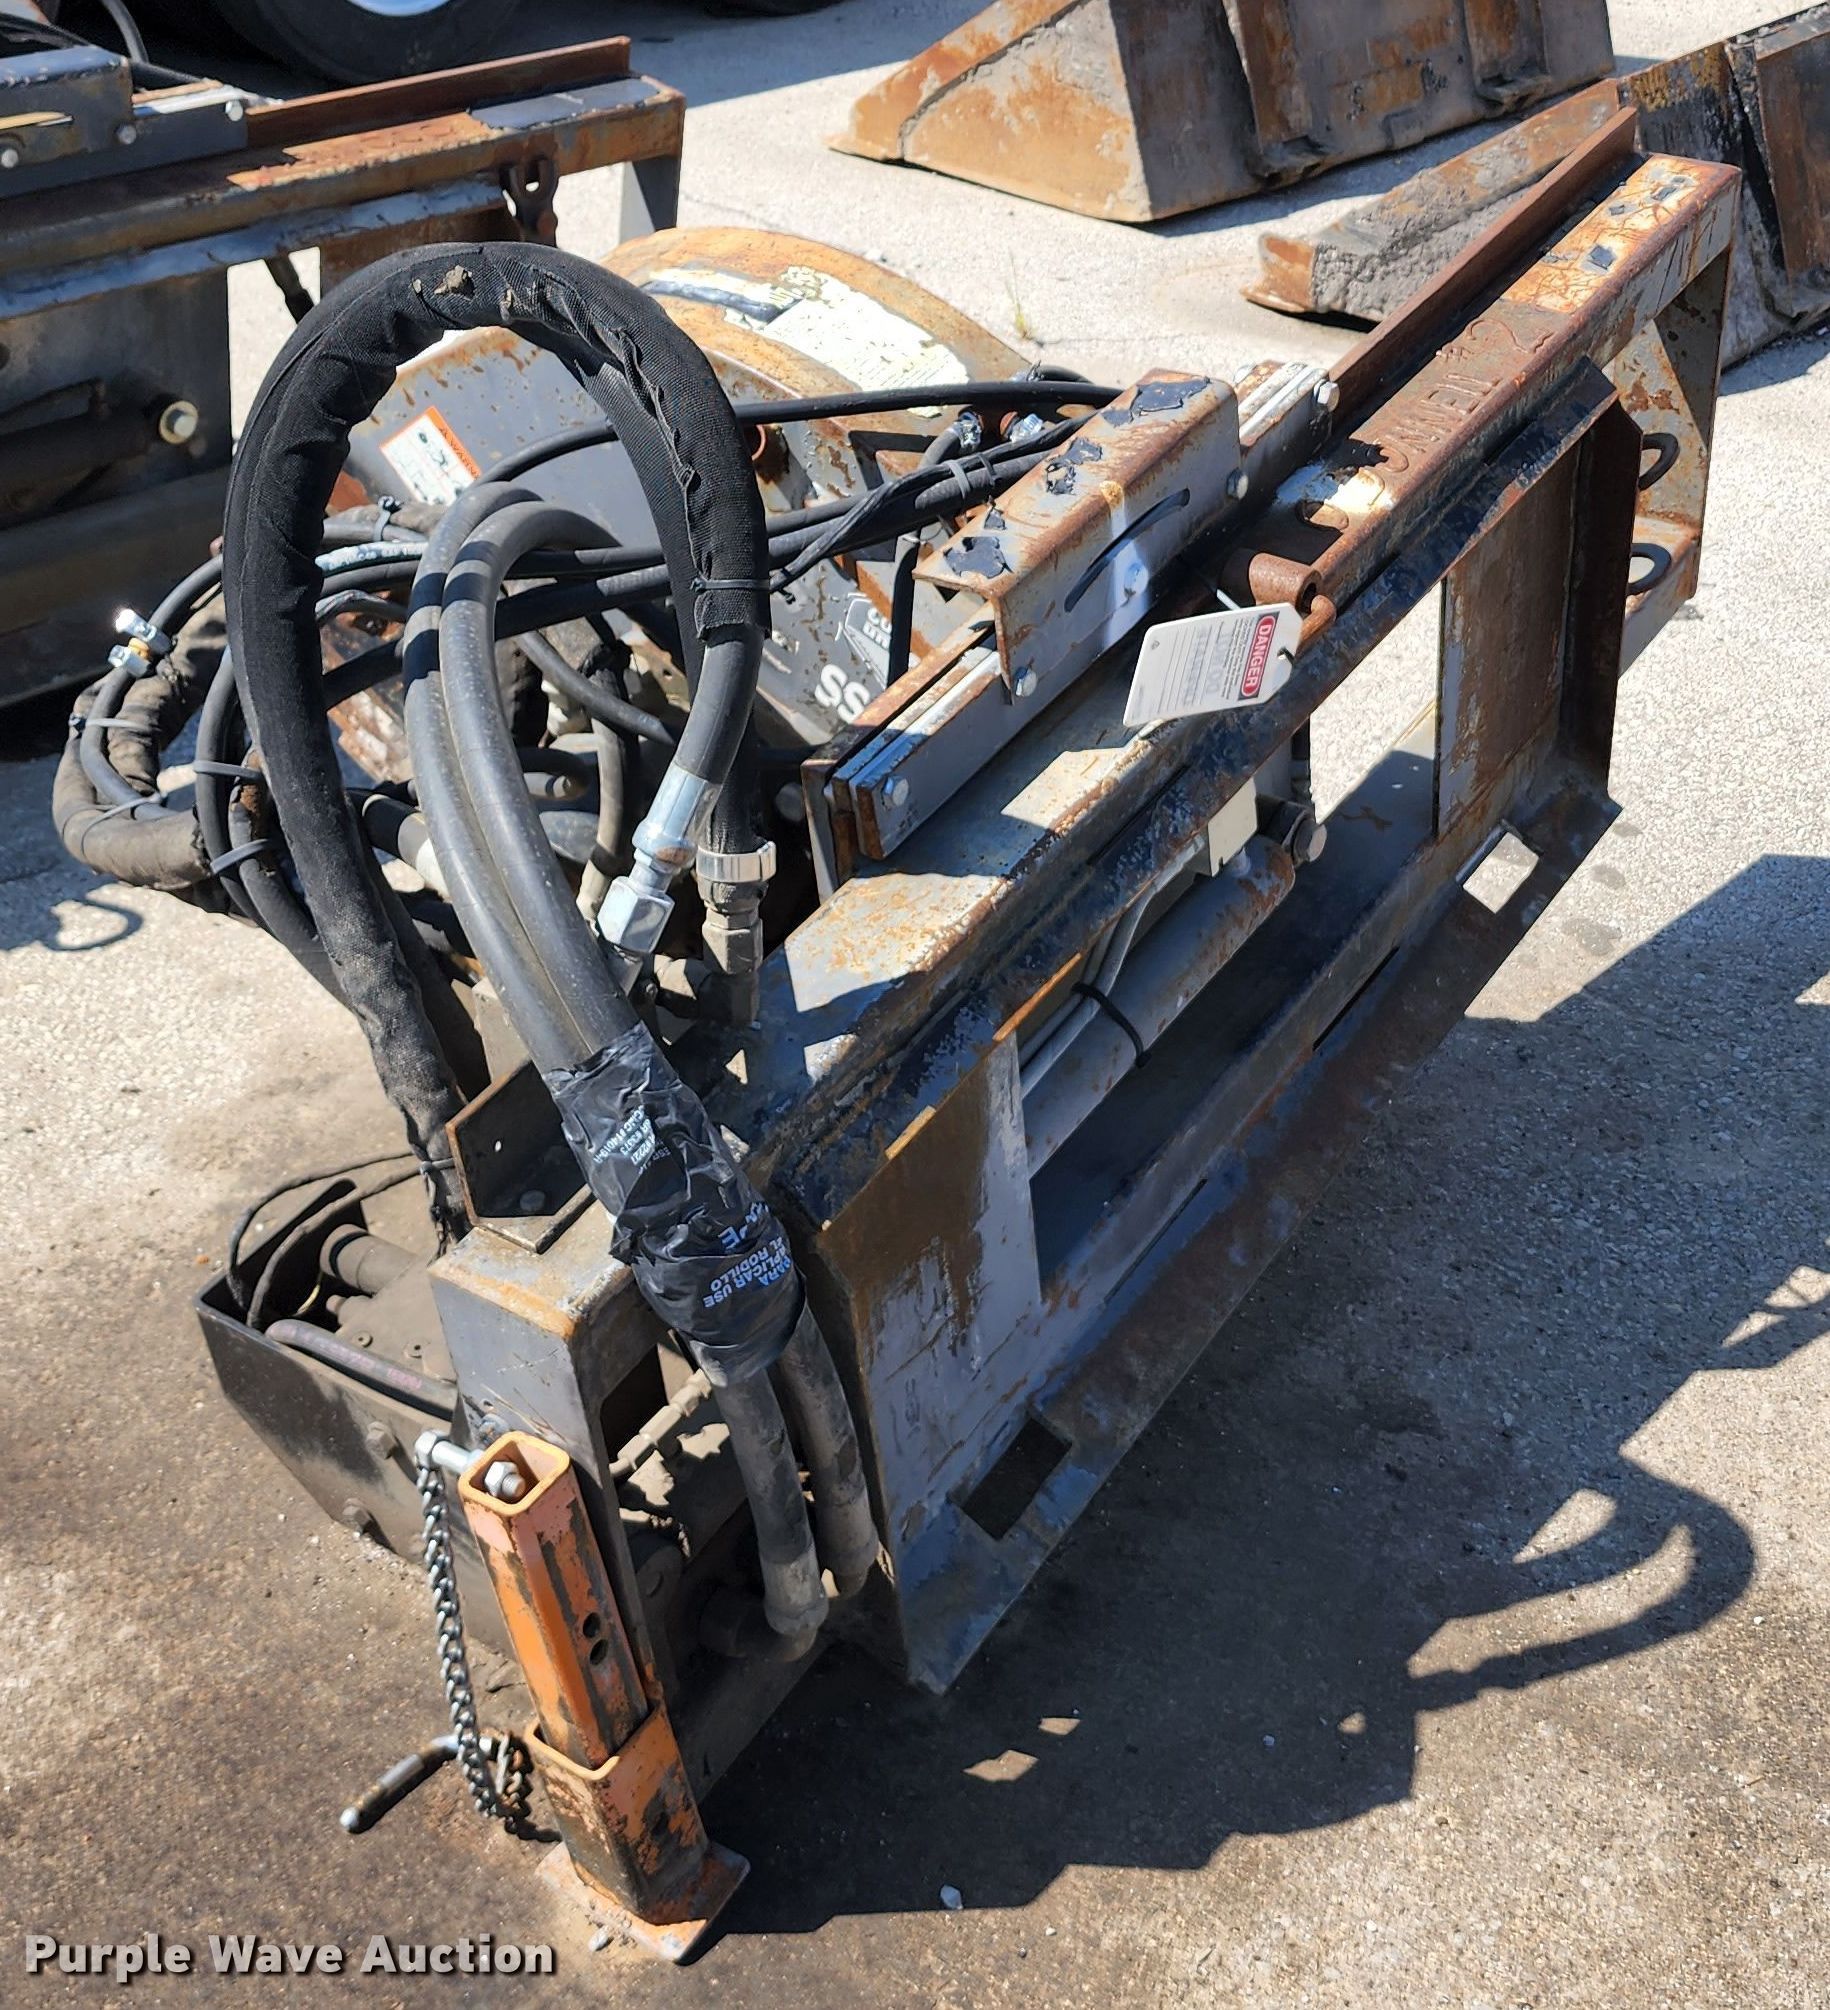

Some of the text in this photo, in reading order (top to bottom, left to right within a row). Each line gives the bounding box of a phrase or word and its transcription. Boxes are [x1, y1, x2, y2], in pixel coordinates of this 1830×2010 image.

[1245, 624, 1272, 692] DANGER
[703, 1245, 786, 1308] APLICAR USE
[710, 1247, 769, 1292] RODILLO
[758, 1255, 791, 1286] PARA
